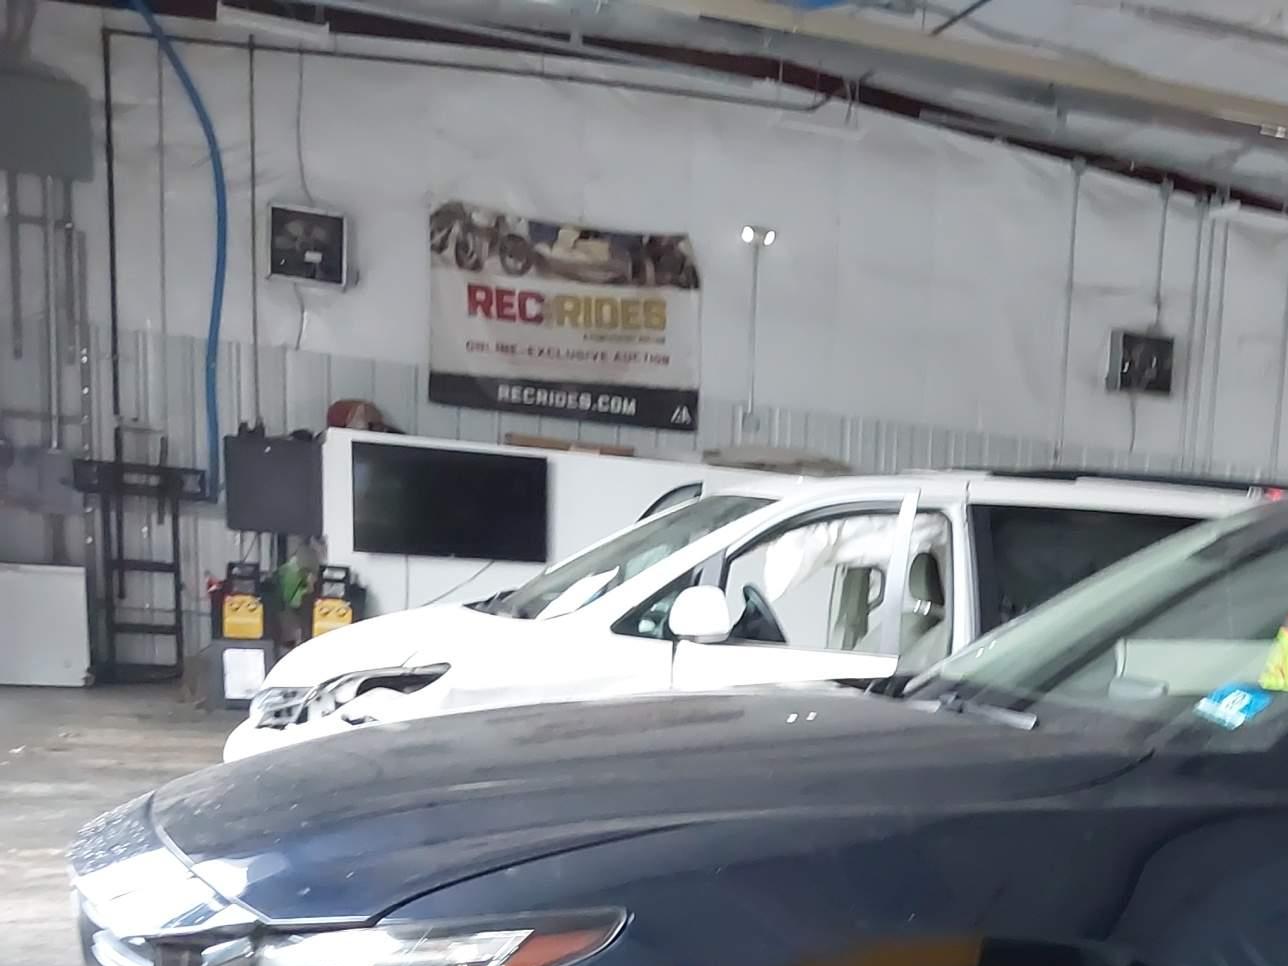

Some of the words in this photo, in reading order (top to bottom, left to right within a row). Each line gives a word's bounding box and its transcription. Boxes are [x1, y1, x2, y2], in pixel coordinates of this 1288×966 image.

[466, 283, 545, 325] REC
[552, 294, 667, 330] RIDES
[497, 383, 637, 416] RECRIDES.COM
